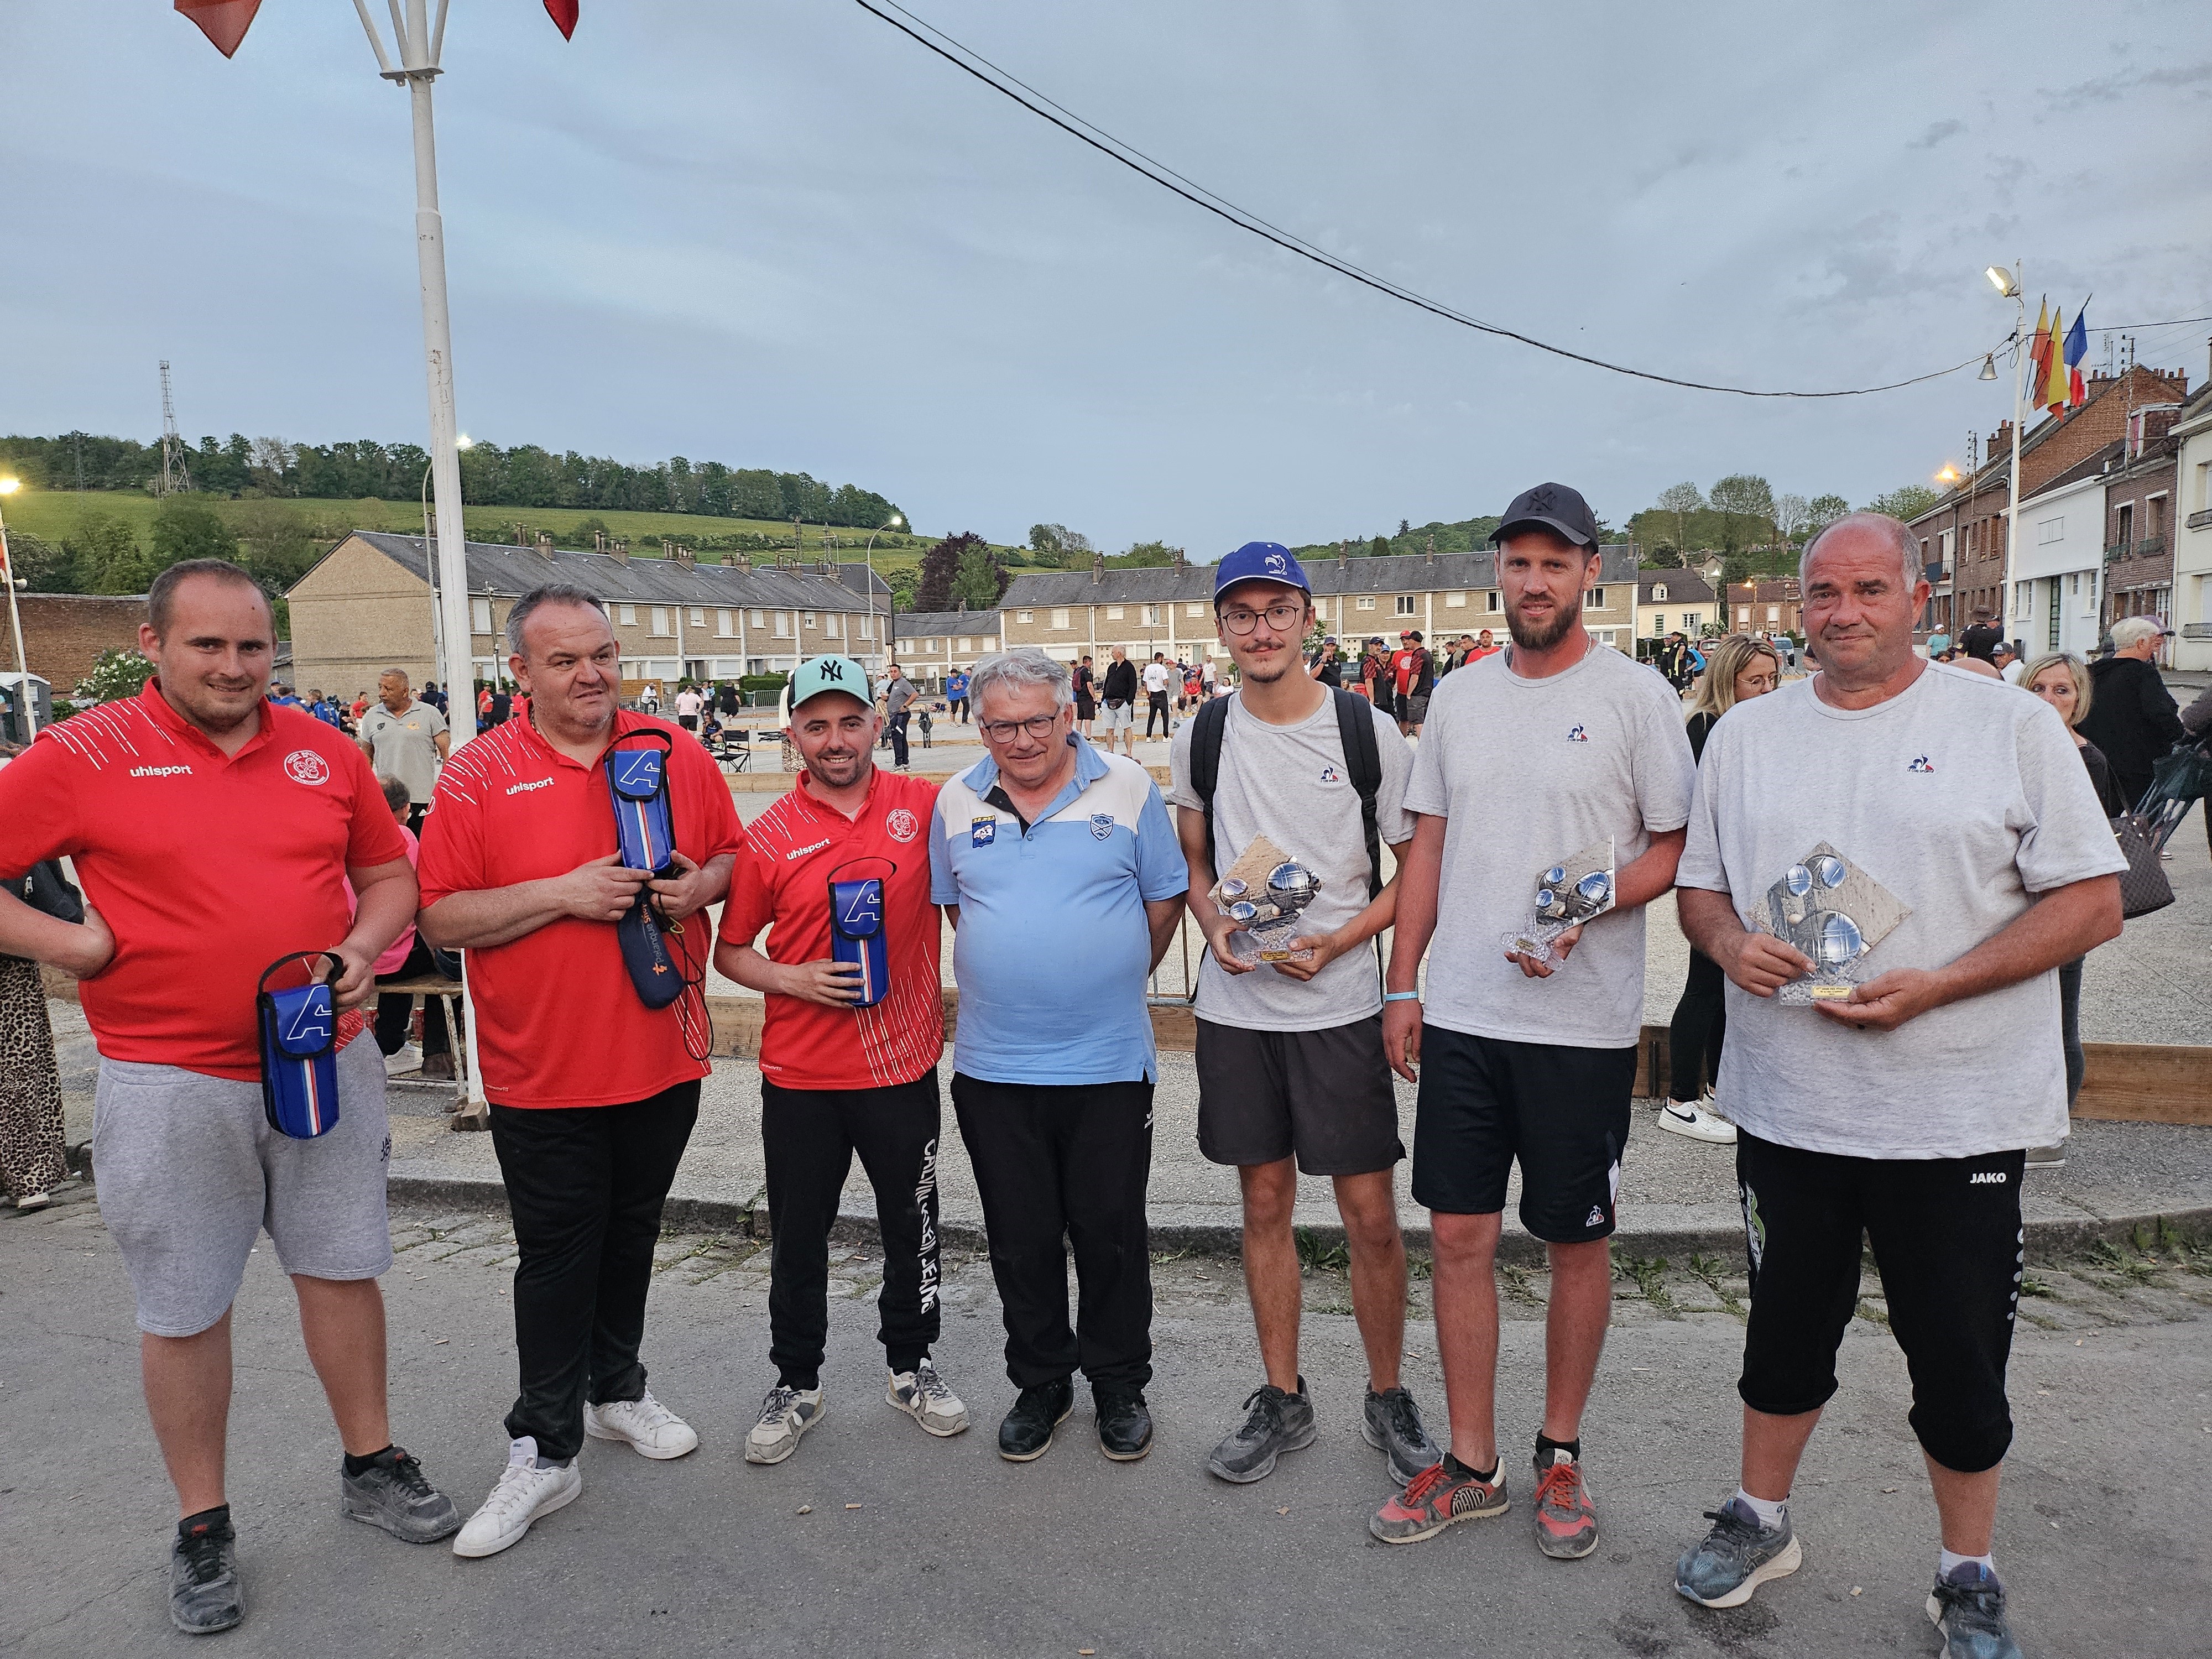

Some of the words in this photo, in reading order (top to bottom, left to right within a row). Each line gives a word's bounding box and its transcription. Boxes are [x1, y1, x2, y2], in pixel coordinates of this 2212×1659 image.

[820, 660, 843, 681] NY
[130, 765, 193, 778] uhlsport
[506, 777, 555, 795] uhlsport
[786, 838, 831, 860] uhlsport
[915, 1139, 936, 1206] CALVIN
[1970, 1172, 2006, 1183] JAKO
[919, 1258, 938, 1314] JEANS
